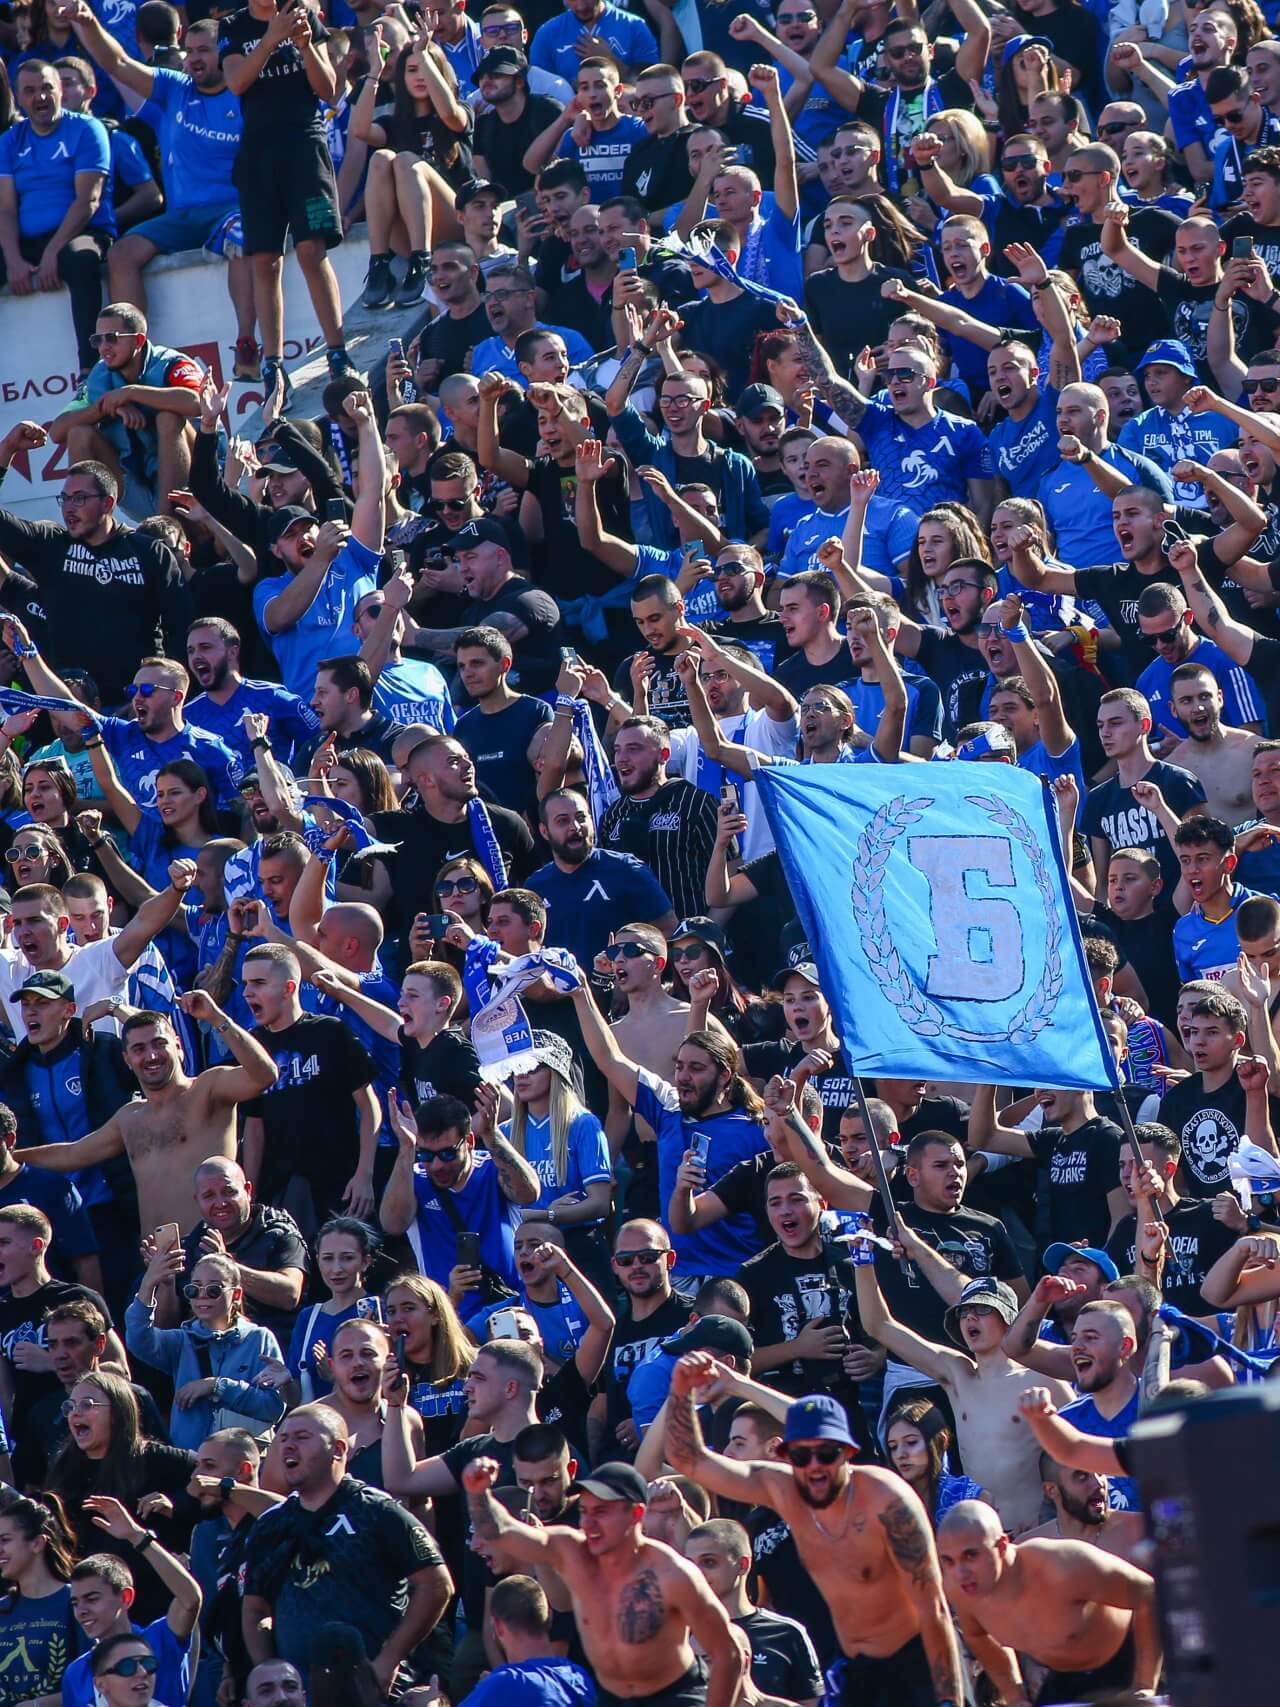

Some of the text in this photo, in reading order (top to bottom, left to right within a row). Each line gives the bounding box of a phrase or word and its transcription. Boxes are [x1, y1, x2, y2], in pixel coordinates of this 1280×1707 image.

[183, 121, 240, 142] VIVACOM
[579, 144, 631, 157] UNDER
[390, 701, 440, 719] ЛЕВСК
[906, 834, 1026, 1003] 6
[1183, 1110, 1237, 1150] ULTRAS LEVSKI SOFIA
